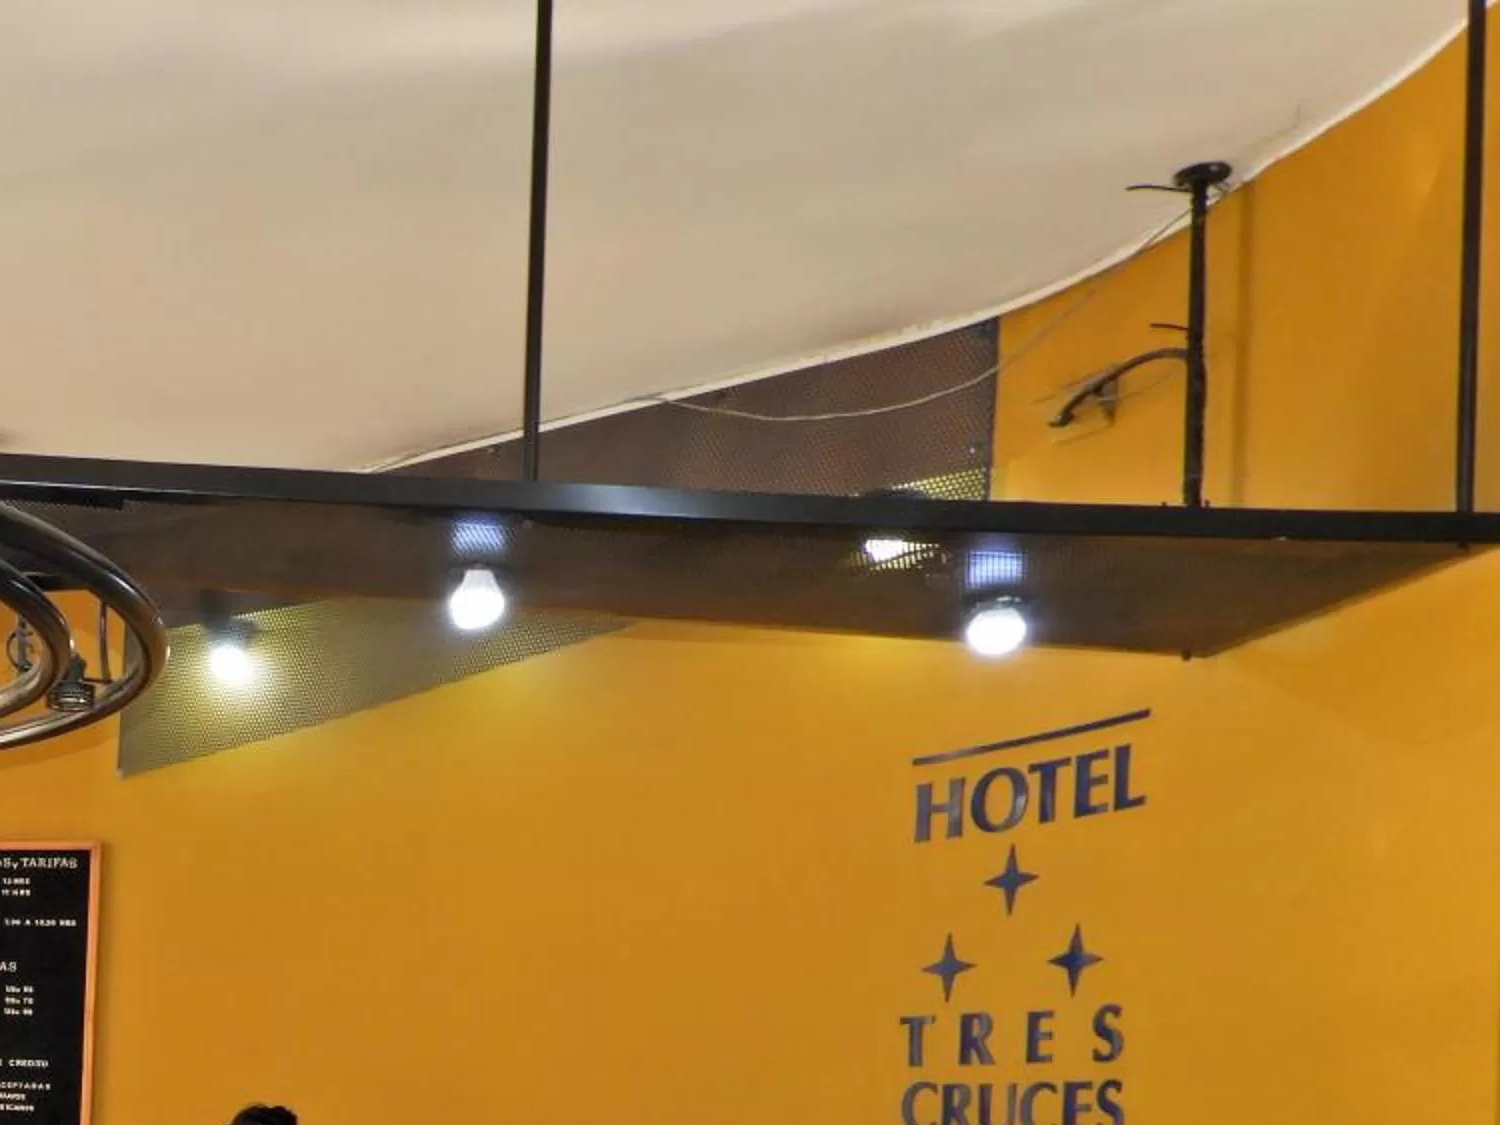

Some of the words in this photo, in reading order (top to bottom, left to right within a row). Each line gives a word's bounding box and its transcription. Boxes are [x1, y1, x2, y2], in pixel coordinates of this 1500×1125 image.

[913, 743, 1147, 843] HOTEL
[21, 857, 78, 869] TARIFAS
[900, 1003, 1125, 1068] TRES
